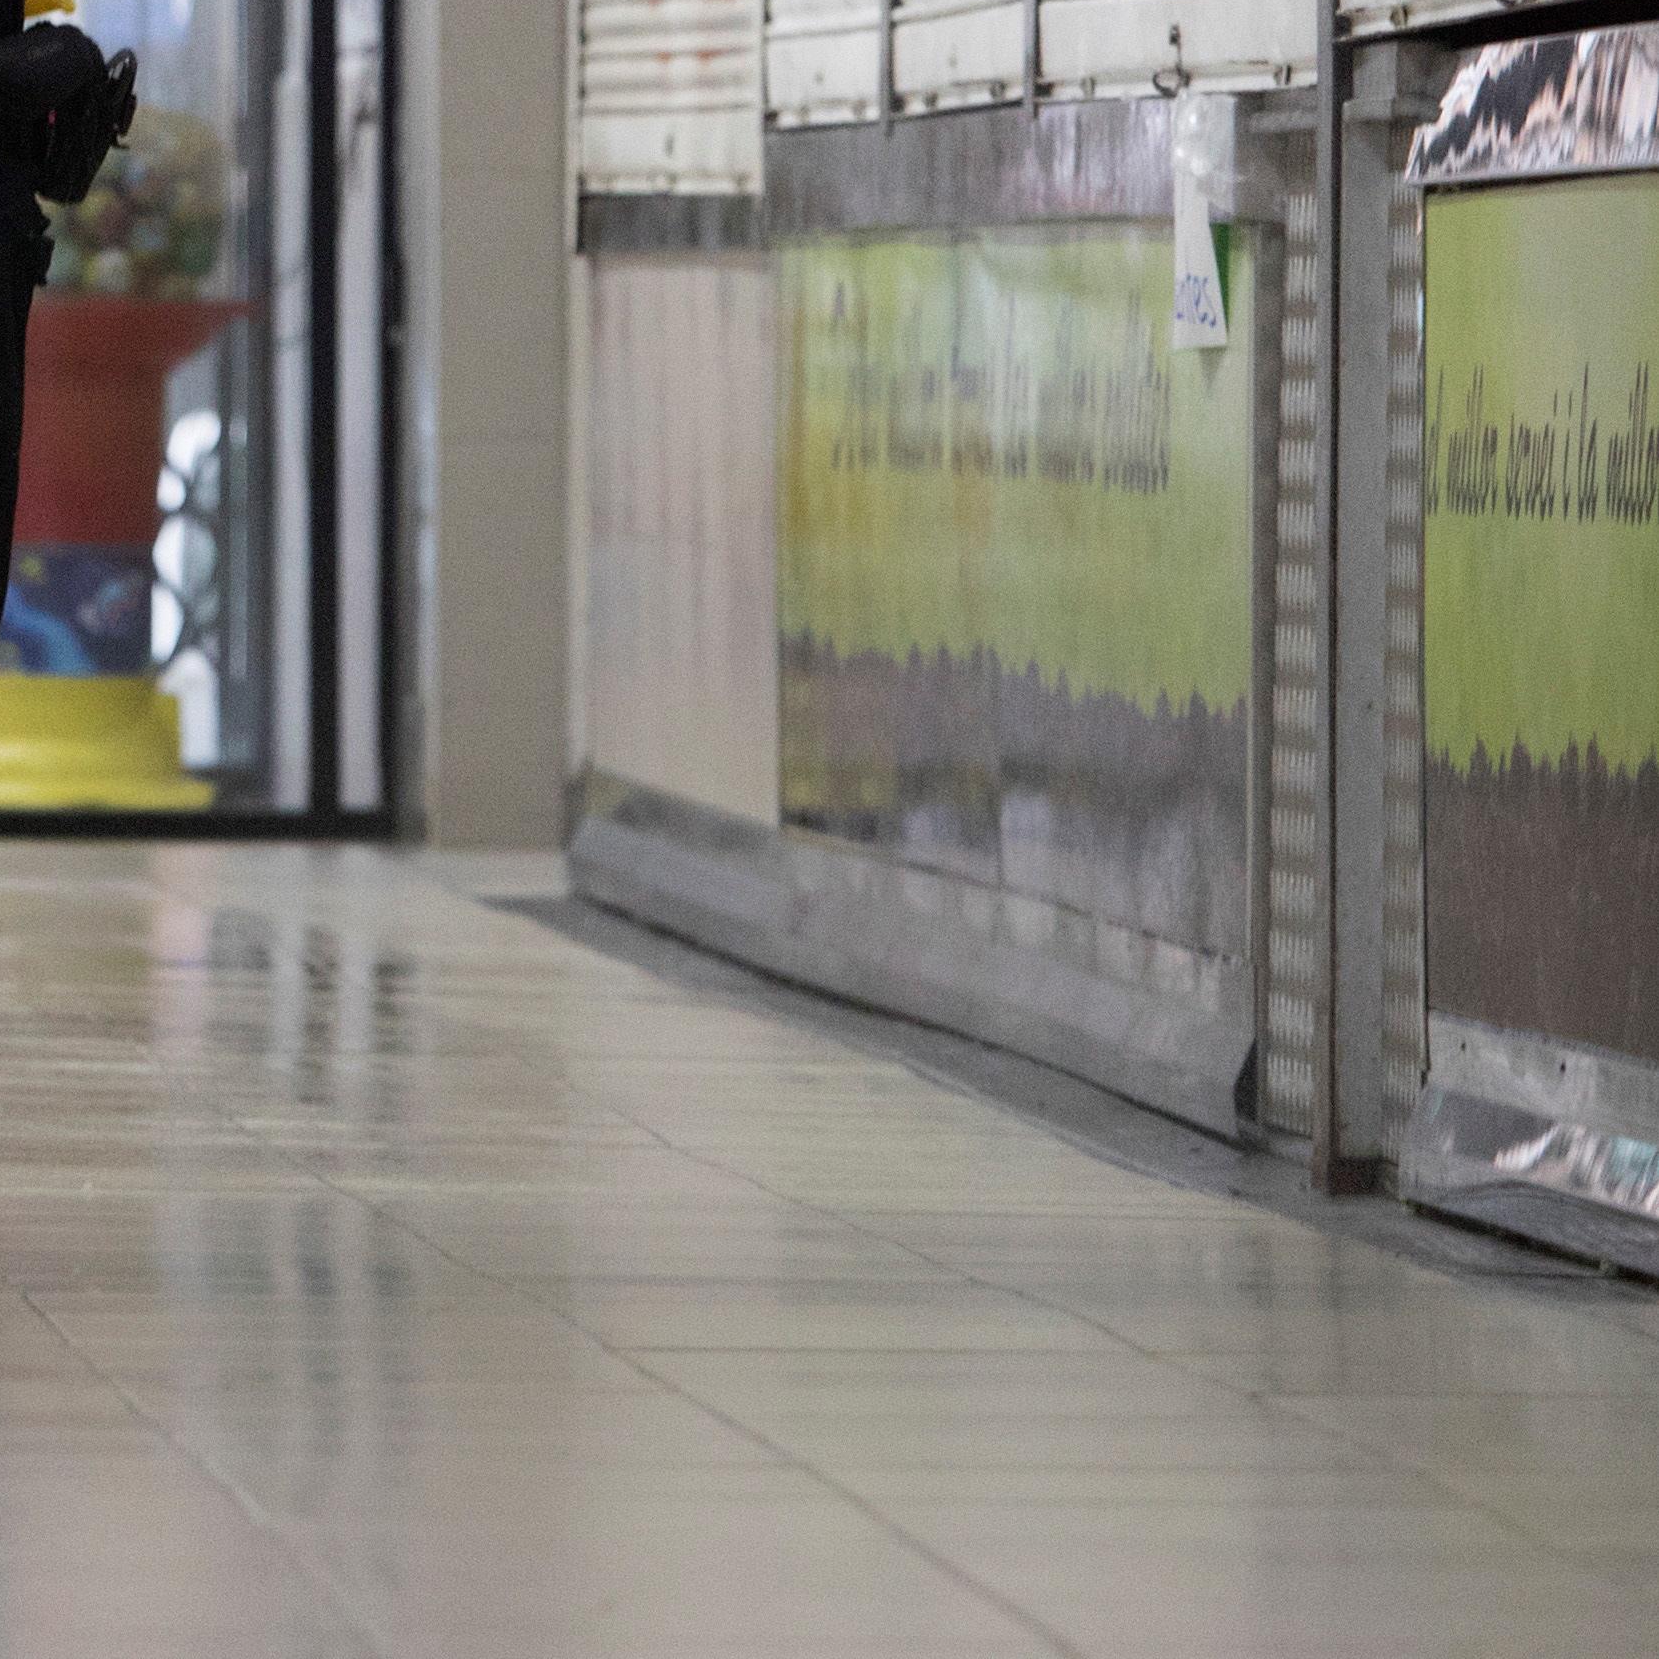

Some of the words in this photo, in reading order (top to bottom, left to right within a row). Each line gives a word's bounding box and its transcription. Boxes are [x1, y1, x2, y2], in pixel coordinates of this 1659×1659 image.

[1447, 363, 1498, 518] millor
[1561, 390, 1572, 523] i
[1578, 361, 1599, 525] la
[1605, 360, 1659, 526] millo
